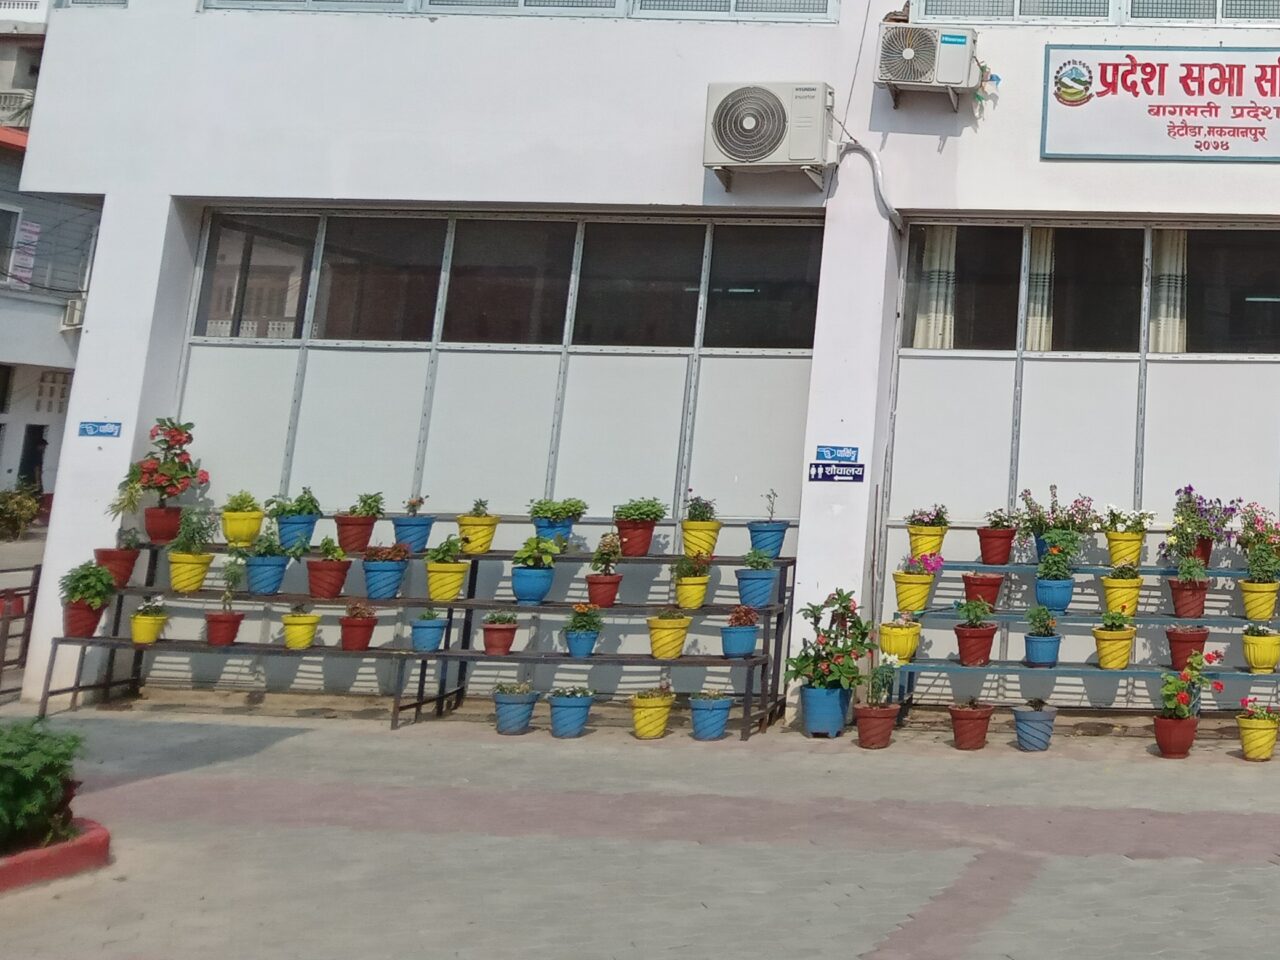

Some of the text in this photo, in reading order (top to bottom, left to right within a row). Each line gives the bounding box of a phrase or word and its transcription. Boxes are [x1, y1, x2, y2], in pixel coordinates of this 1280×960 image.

[1095, 53, 1169, 97] प्रदेश
[1180, 62, 1247, 97] सभा
[1148, 101, 1221, 119] बागमती
[825, 465, 864, 476] शौचालय
